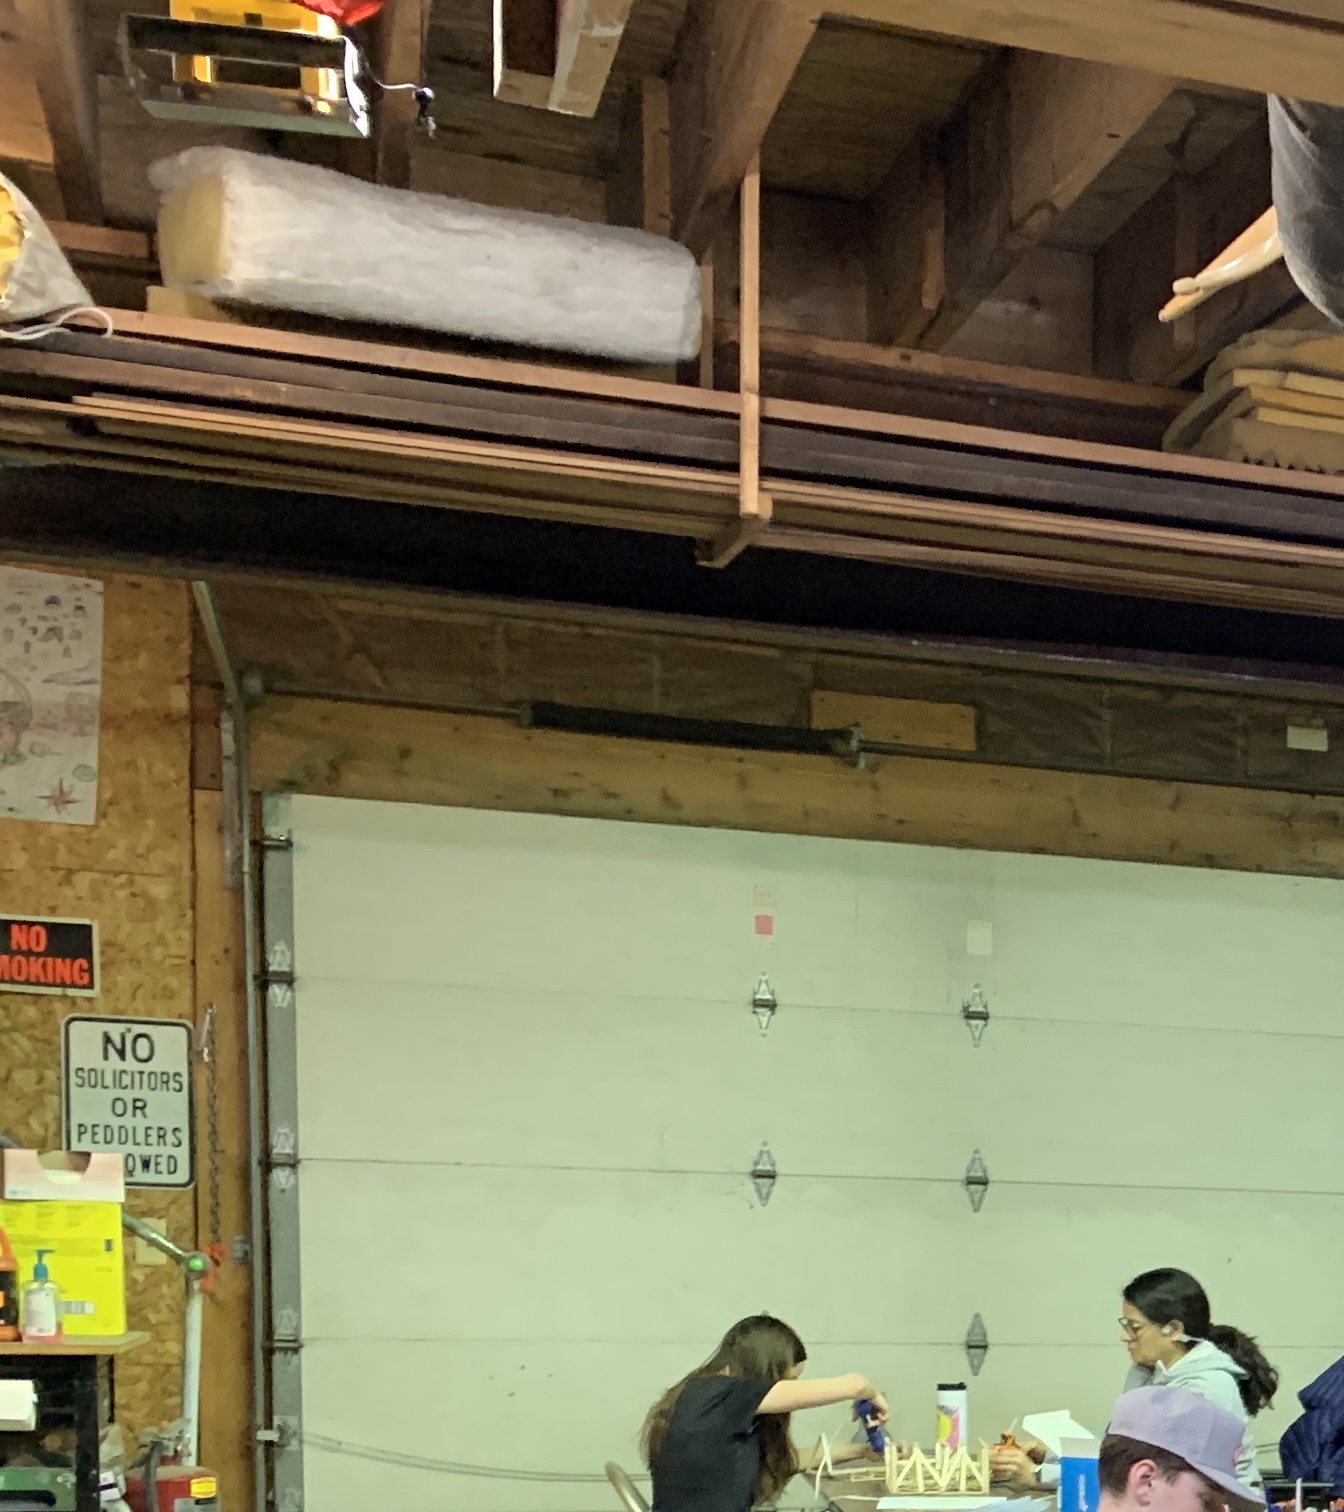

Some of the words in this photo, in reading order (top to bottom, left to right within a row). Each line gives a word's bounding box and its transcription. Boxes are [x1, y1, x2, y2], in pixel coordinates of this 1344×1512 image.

[11, 923, 47, 953] NO
[0, 954, 91, 986] MOKING
[102, 1030, 155, 1064] NO
[74, 1067, 183, 1093] SOLICITORS
[111, 1097, 147, 1119] OR
[77, 1123, 182, 1148] PEDDLERS
[125, 1153, 178, 1176] OWED
